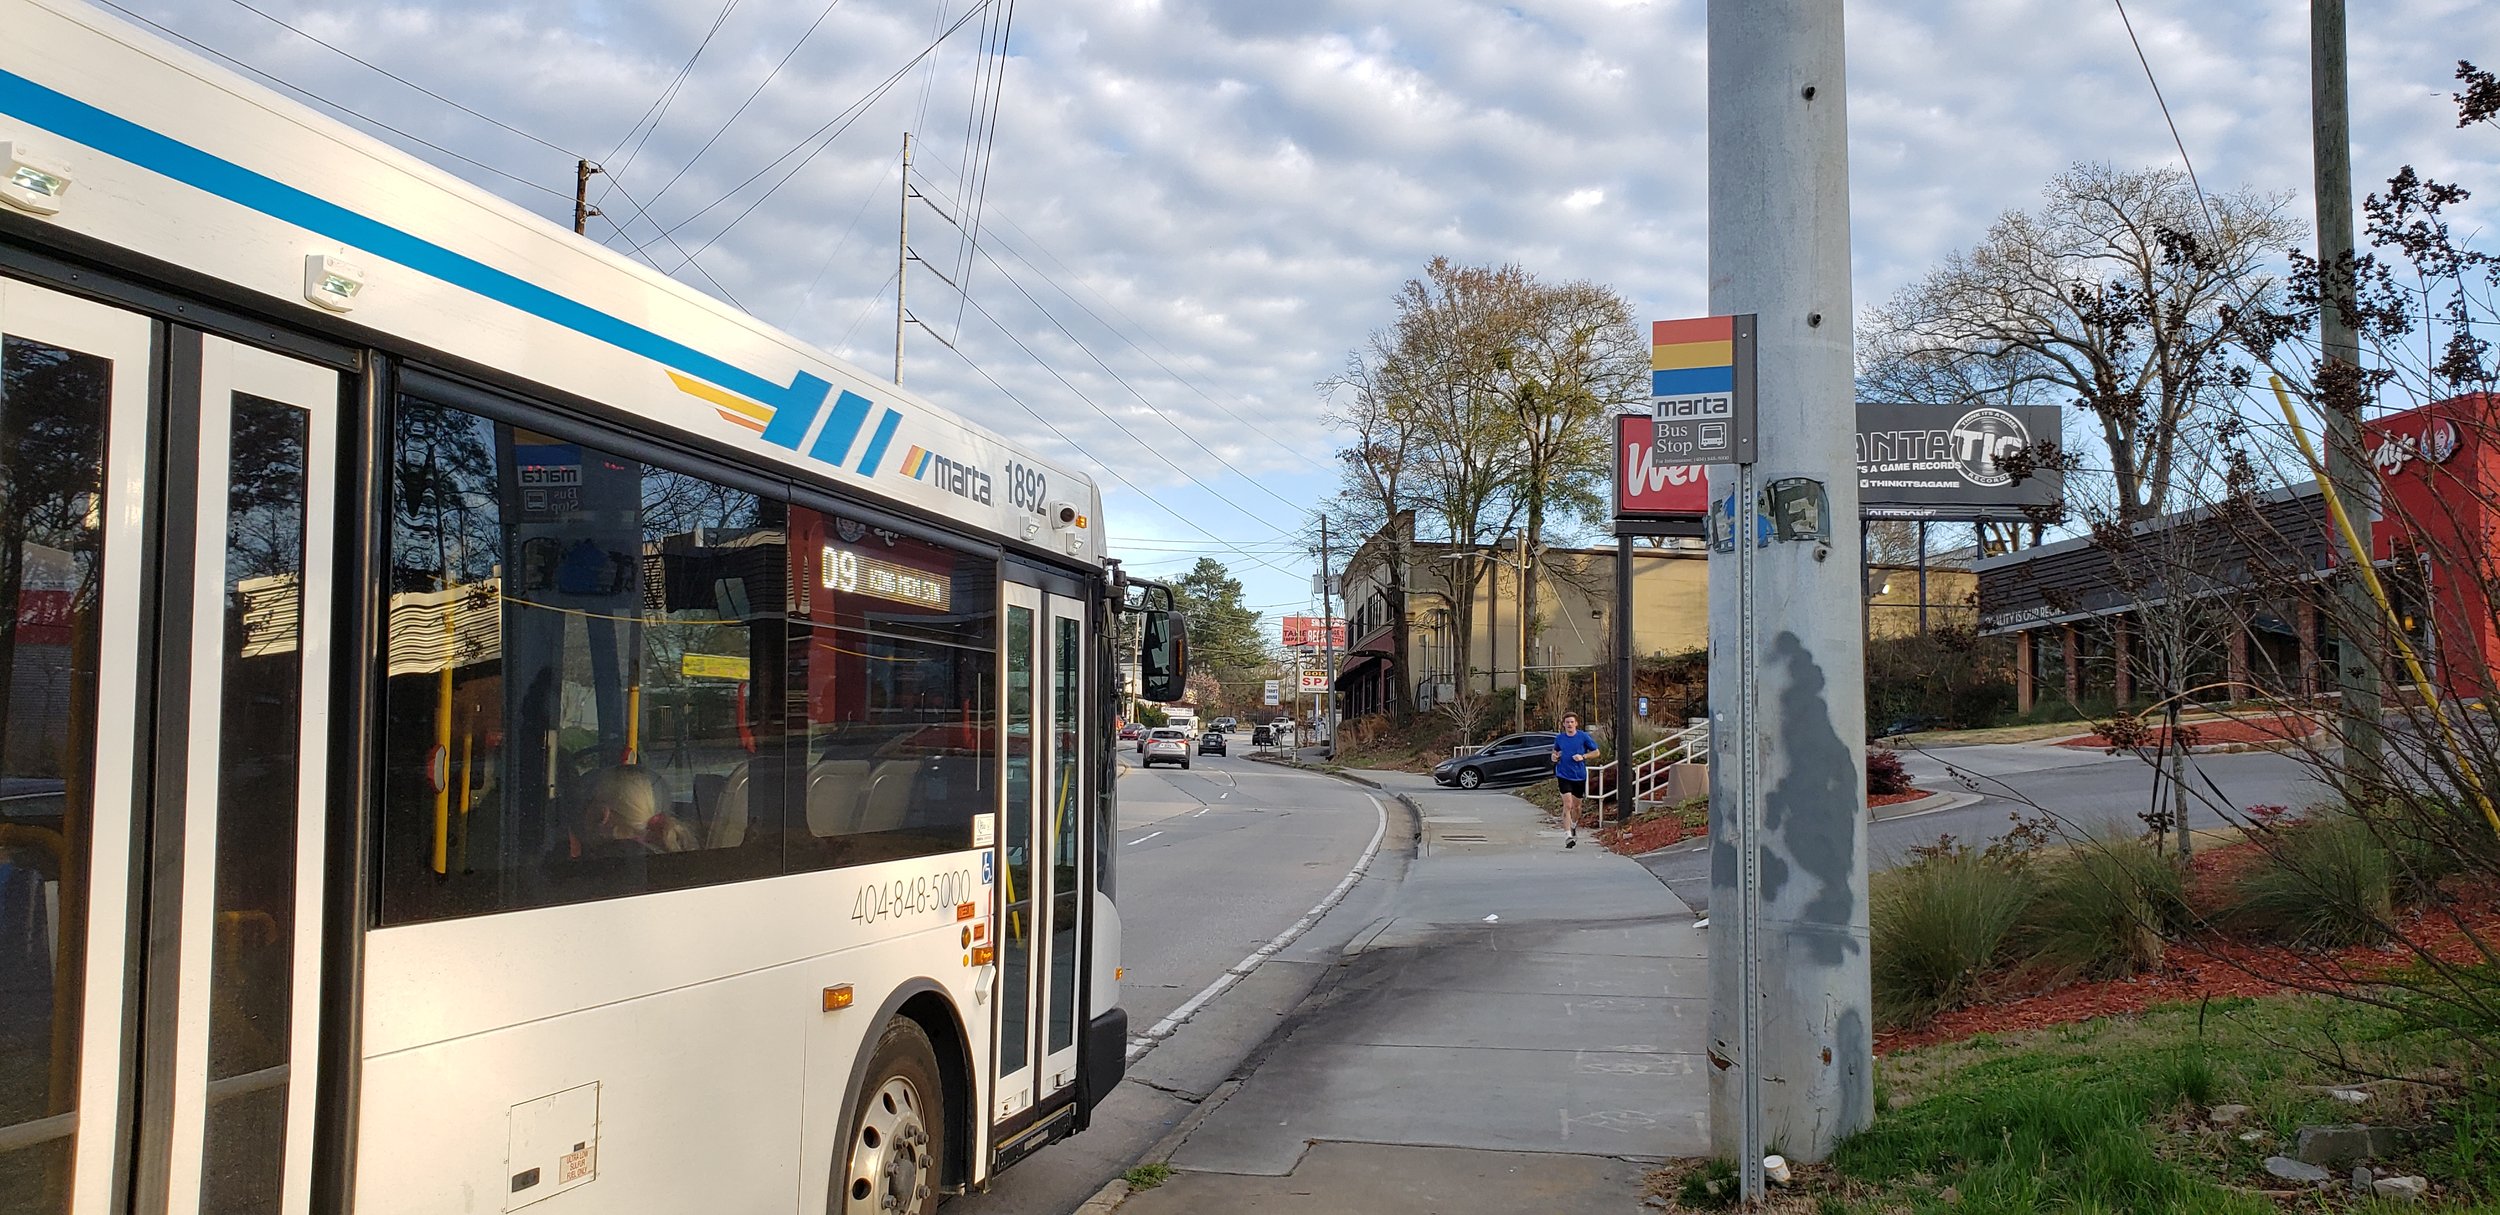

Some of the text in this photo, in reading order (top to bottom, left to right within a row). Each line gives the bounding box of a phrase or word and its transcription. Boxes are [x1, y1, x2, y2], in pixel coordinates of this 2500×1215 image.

[1657, 397, 1728, 417] marta
[1960, 412, 1981, 427] THINK
[2000, 415, 2018, 430] GAME
[1657, 423, 1688, 438] Bus
[1657, 439, 1693, 456] Stop
[1870, 465, 1878, 473] A
[1880, 462, 1910, 472] GAME
[1912, 461, 1962, 471] RECORDS
[935, 454, 1047, 517] marta 1892
[1870, 480, 1960, 488] THINKITSAGAME
[868, 568, 896, 592] KING
[897, 574, 921, 598] MEM
[922, 580, 941, 603] STN
[2015, 610, 2022, 623] IS
[851, 869, 971, 926] 404-848-5000
